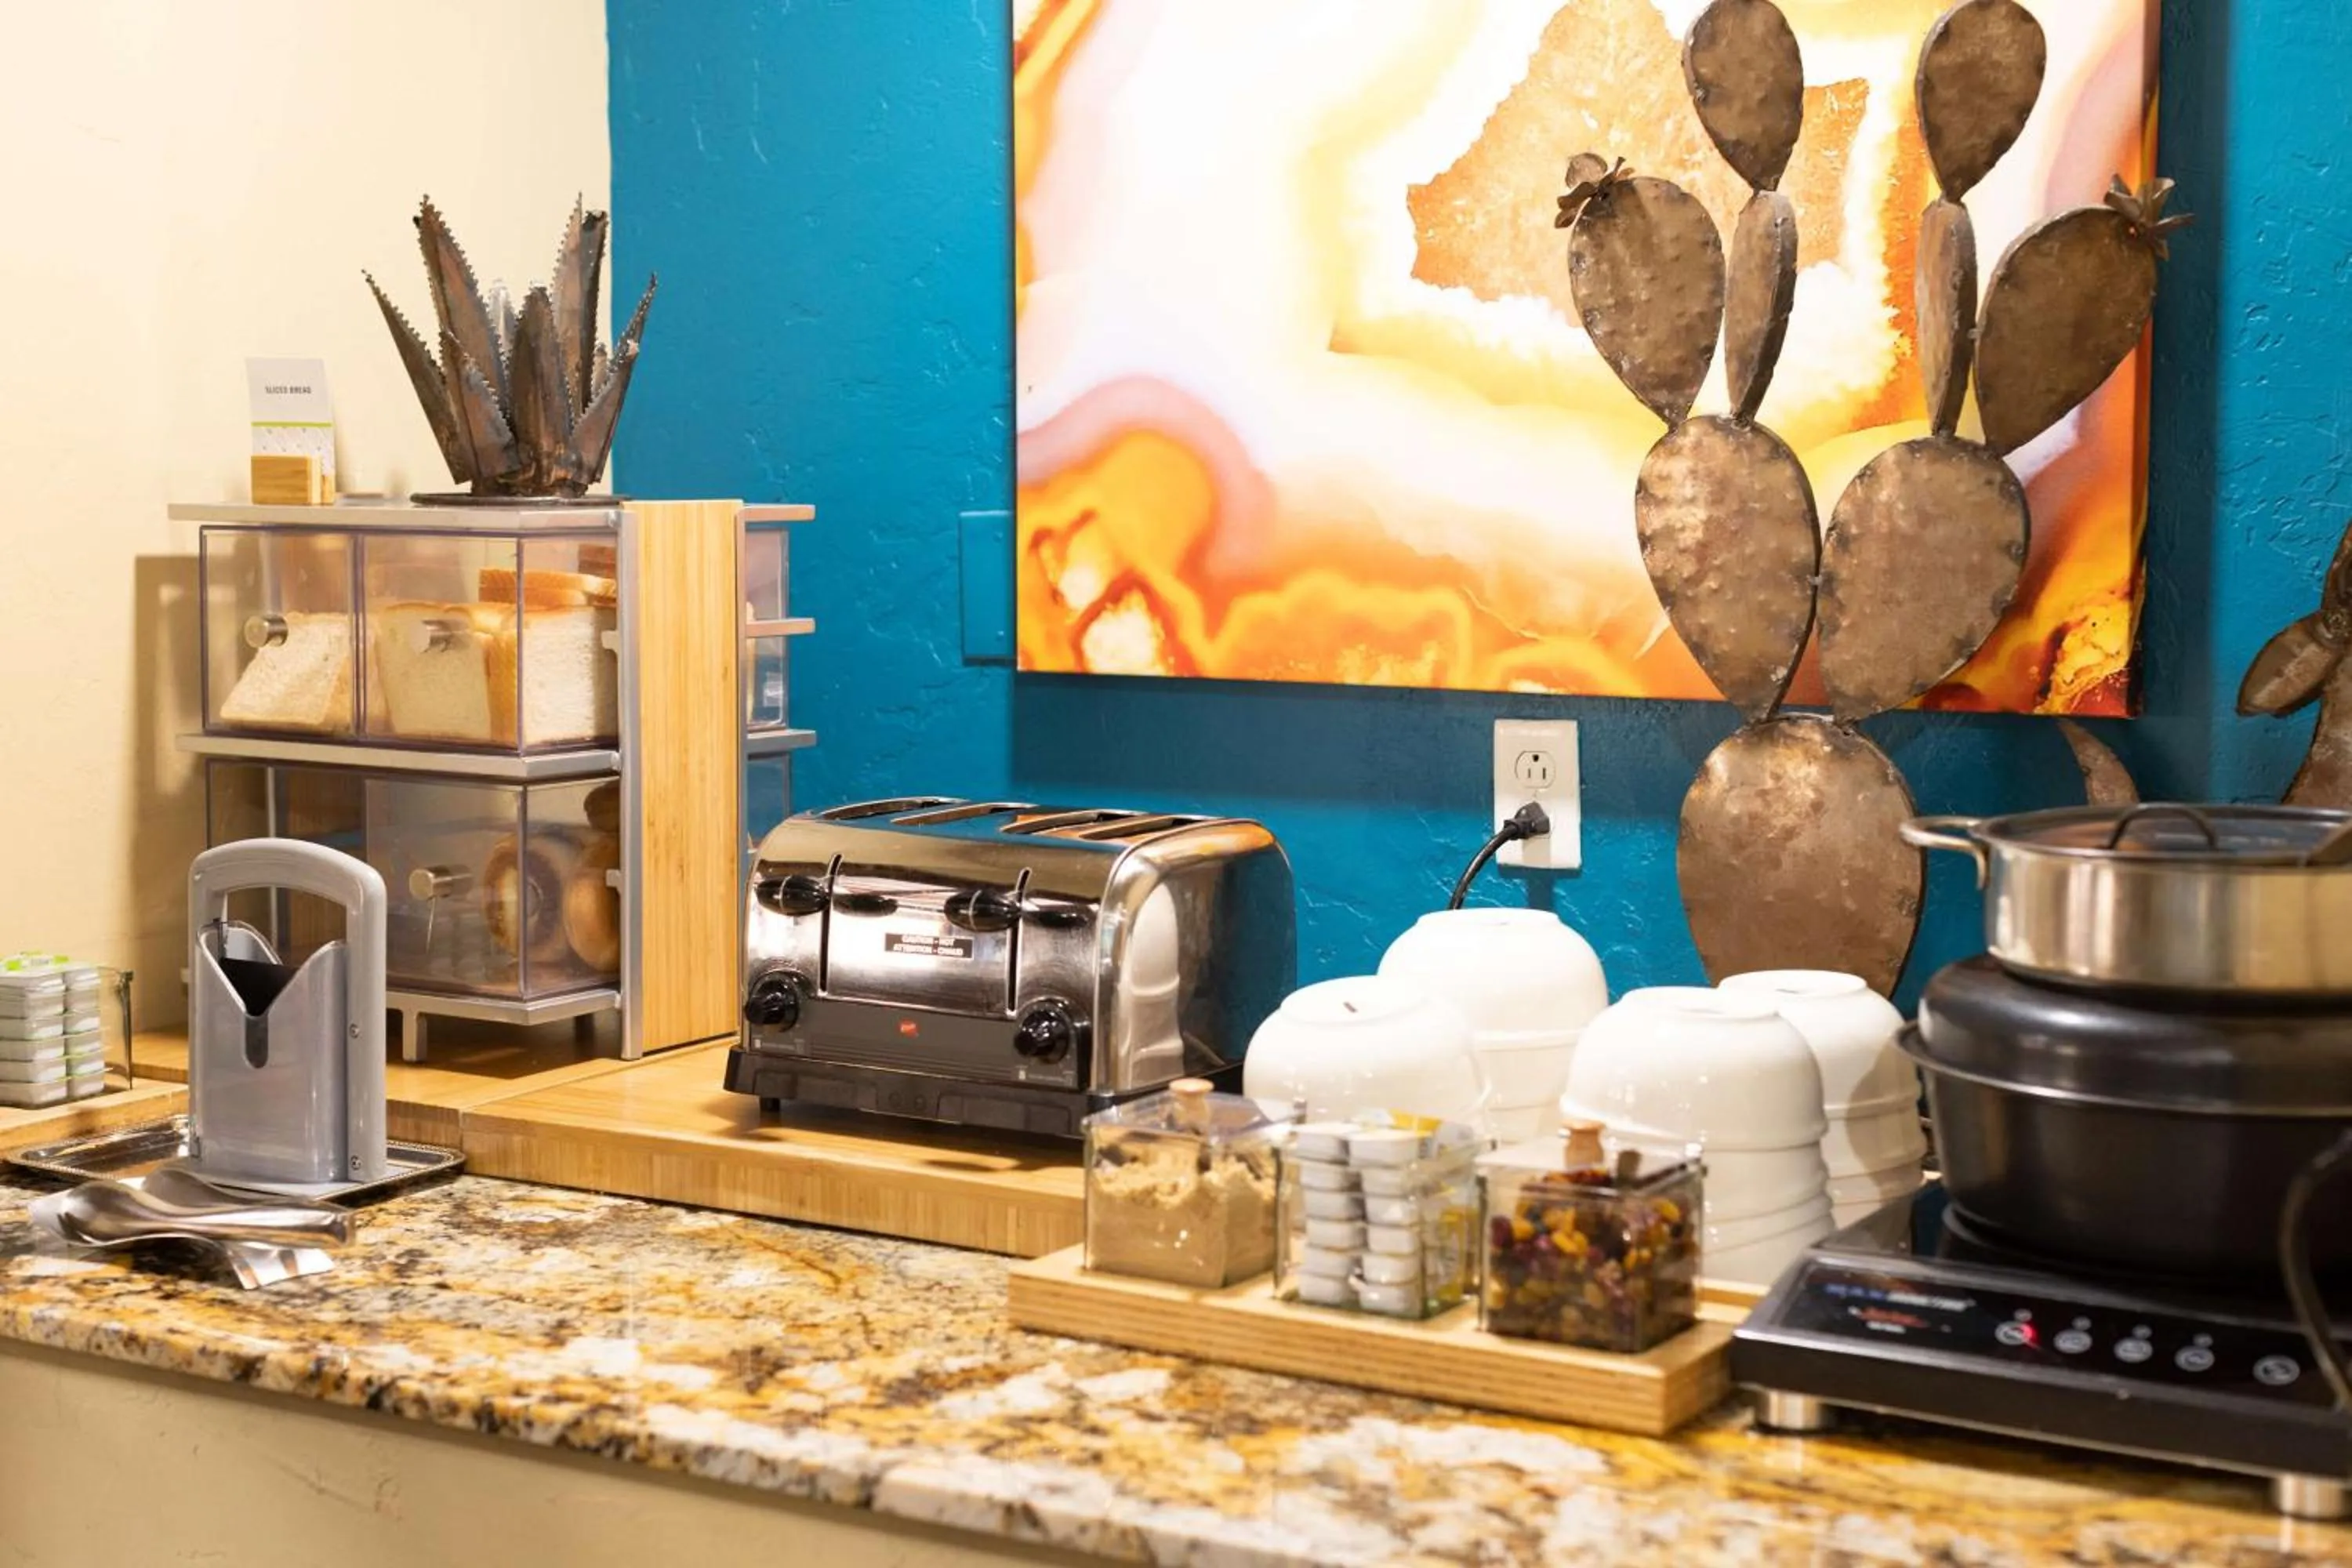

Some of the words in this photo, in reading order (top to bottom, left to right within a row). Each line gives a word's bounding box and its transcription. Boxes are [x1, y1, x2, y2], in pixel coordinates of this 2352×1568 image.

[265, 386, 288, 394] SLICED
[290, 386, 311, 394] BREAD
[894, 943, 931, 953] ATTENTION
